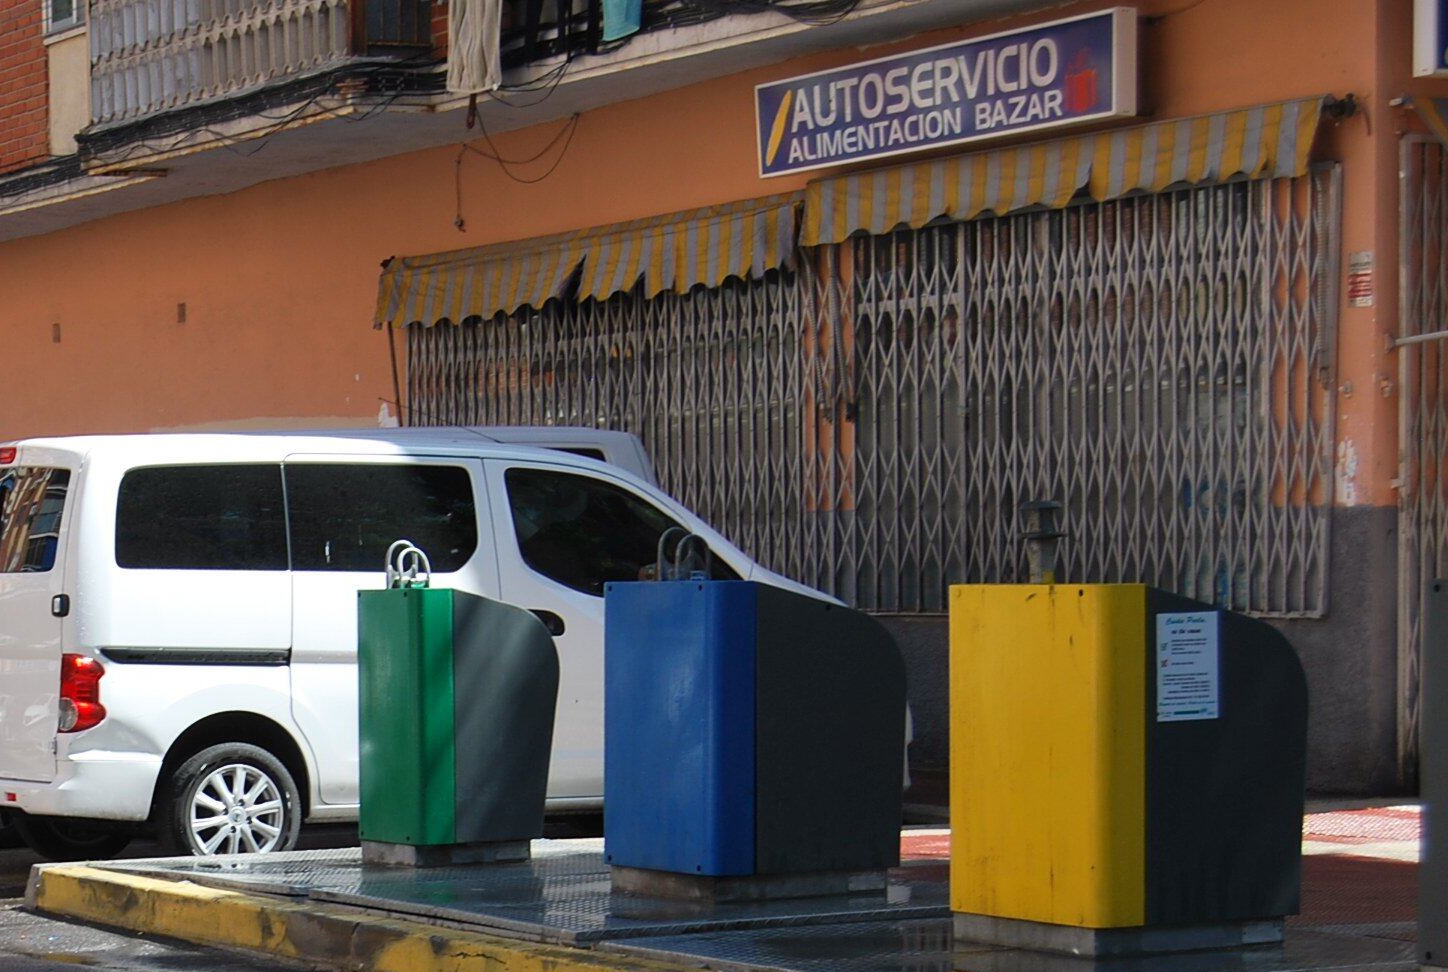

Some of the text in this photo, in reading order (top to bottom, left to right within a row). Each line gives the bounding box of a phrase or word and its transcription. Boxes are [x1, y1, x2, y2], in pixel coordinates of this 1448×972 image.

[788, 89, 1063, 164] ALIMENTACION BAZAR
[791, 37, 1058, 133] AUTOSERVICIO
